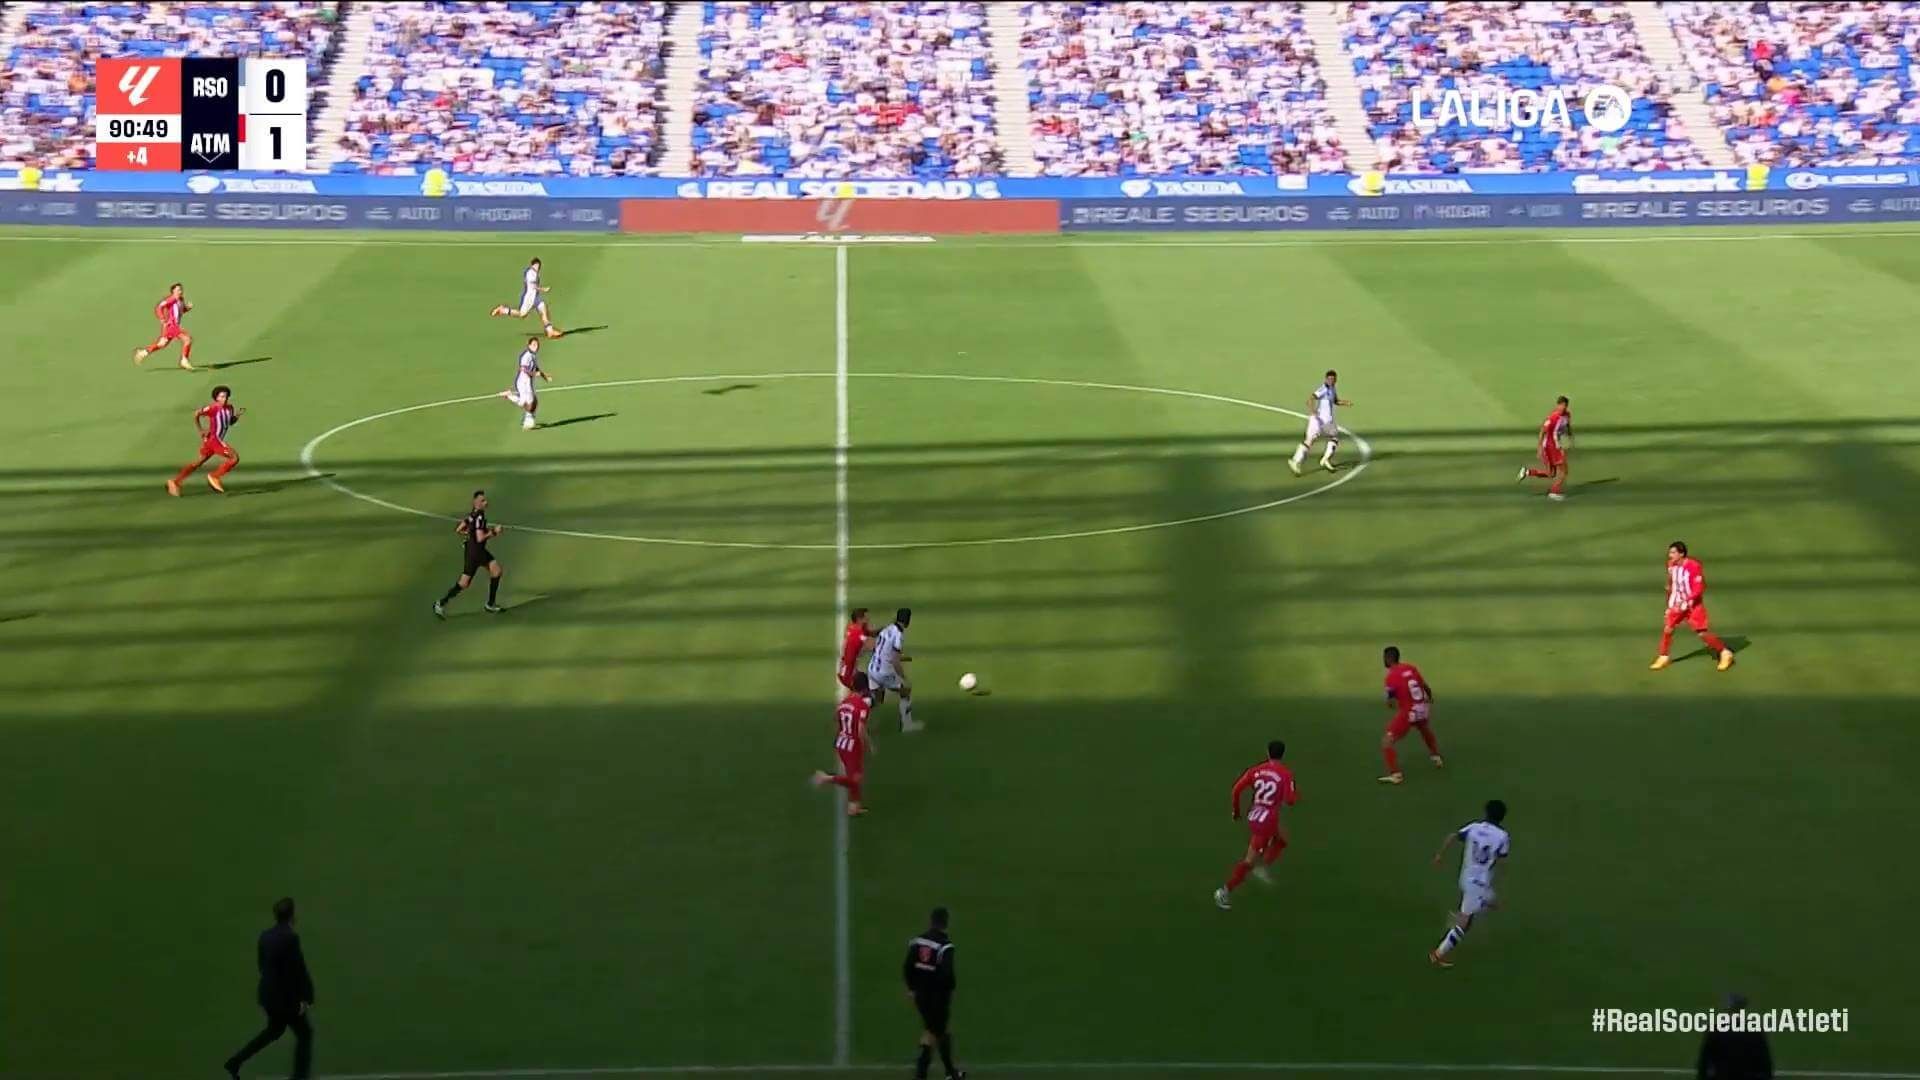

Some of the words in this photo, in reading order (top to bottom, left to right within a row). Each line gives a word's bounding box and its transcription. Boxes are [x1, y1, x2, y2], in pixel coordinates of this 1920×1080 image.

[707, 182, 793, 199] REAL
[214, 203, 348, 221] SEGUROS
[1091, 206, 1176, 224] REALE
[1183, 205, 1309, 223] SEGUROS
[1600, 200, 1687, 218] REALE
[1696, 199, 1829, 216] SEGUROS
[1408, 679, 1424, 701] 6
[1254, 779, 1277, 805] 22
